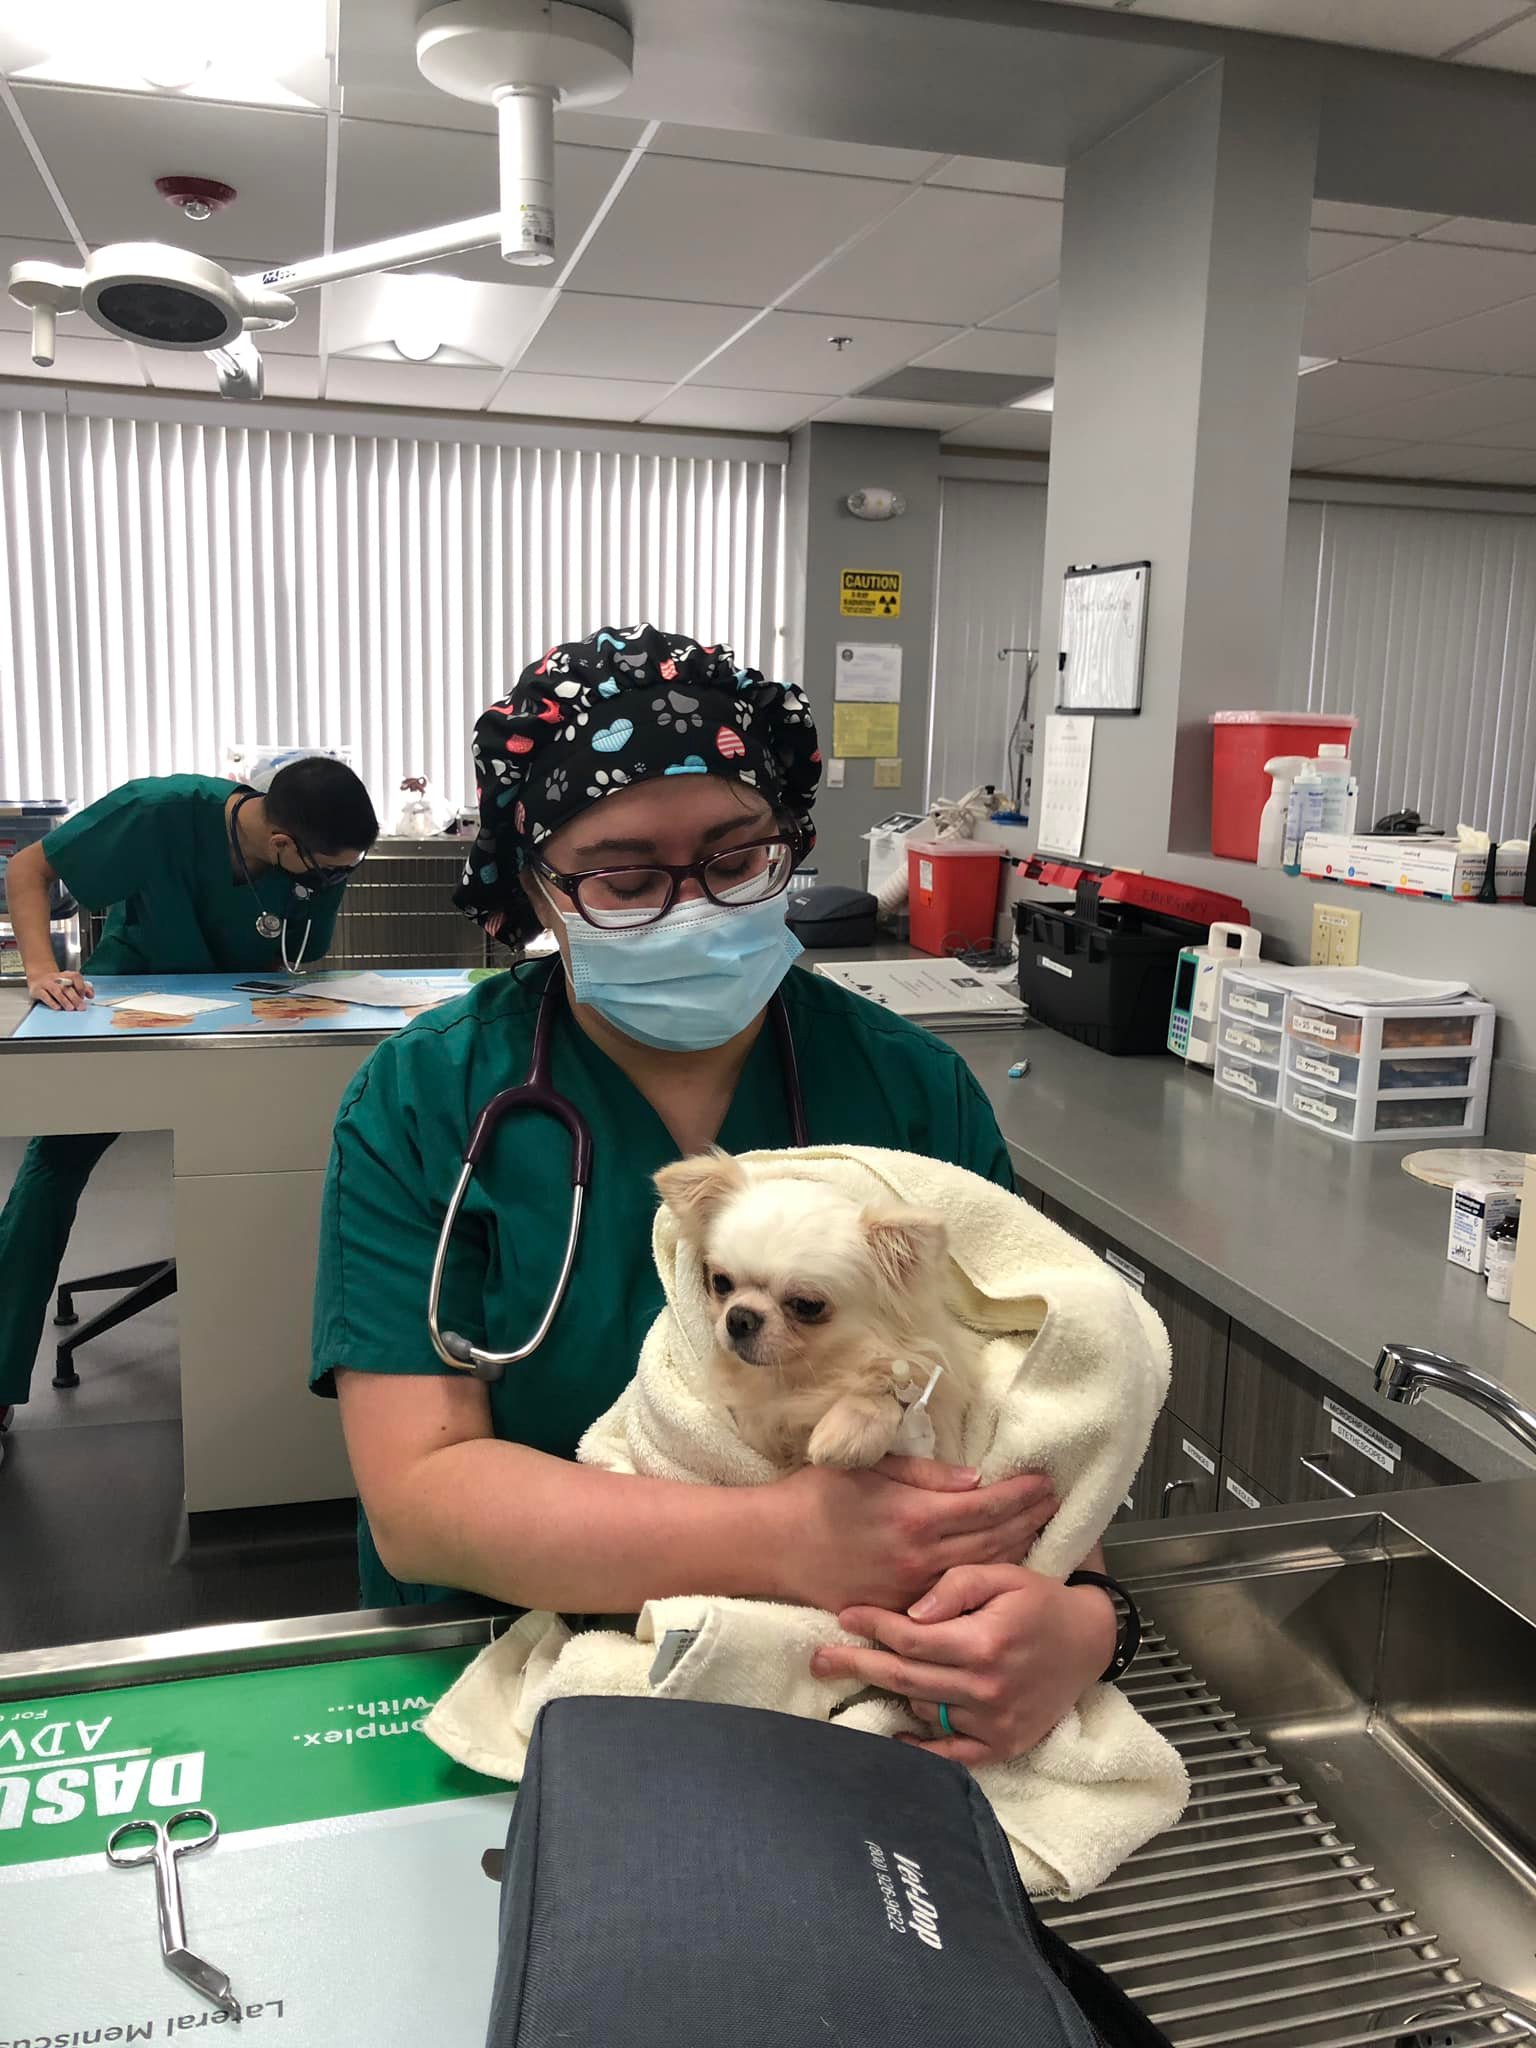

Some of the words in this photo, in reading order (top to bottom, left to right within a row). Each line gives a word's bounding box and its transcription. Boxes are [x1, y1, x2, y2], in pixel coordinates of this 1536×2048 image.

[845, 575, 898, 590] CAUTION
[11, 1709, 48, 1721] For
[293, 1720, 425, 1747] omplex.
[864, 1840, 889, 1872] (800)
[876, 1872, 907, 1934] 926-9622
[893, 1851, 943, 1950] Vet-Dop
